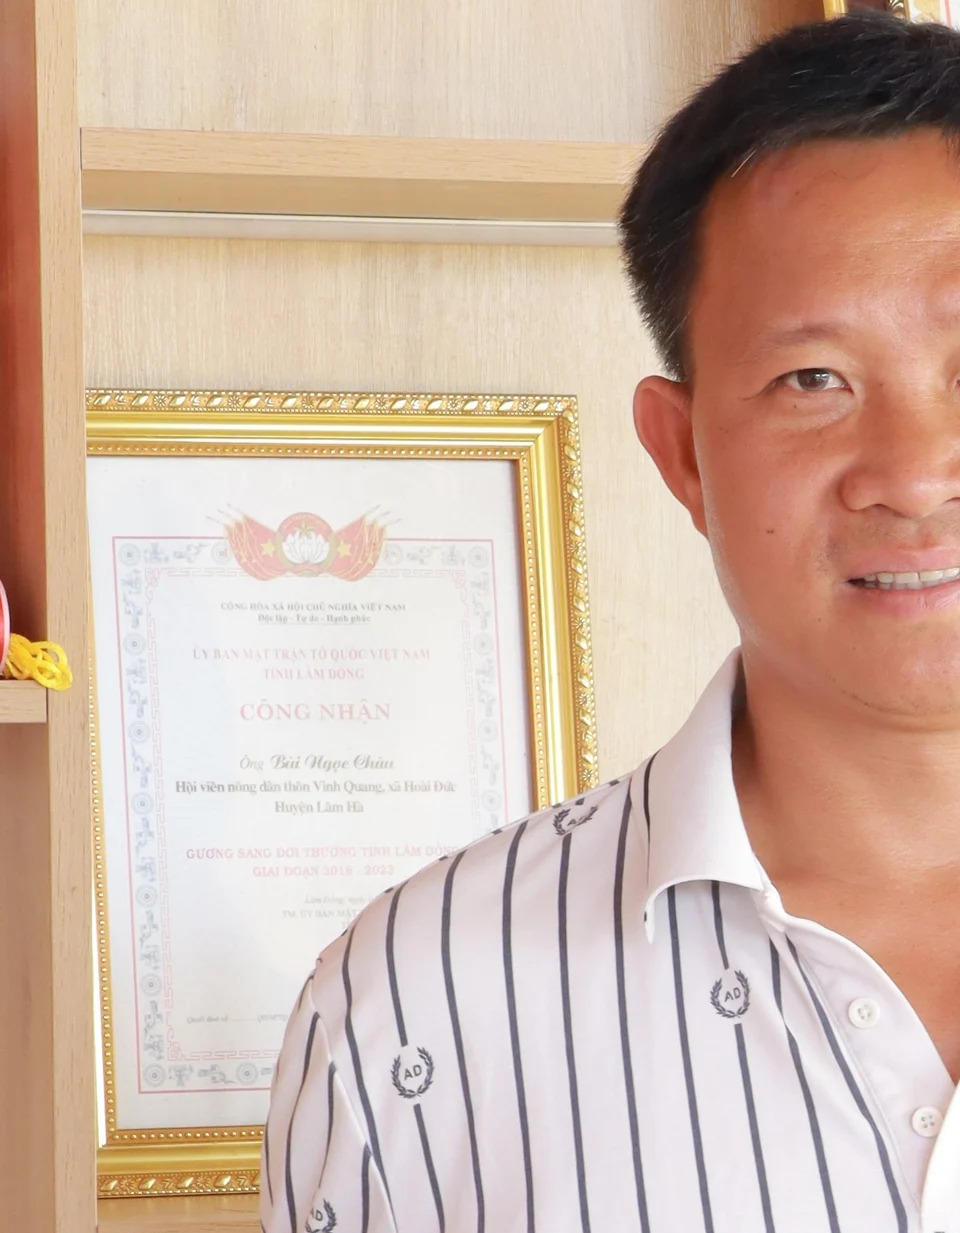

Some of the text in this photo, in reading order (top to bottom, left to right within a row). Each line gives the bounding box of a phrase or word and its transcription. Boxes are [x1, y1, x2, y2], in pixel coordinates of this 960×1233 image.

[239, 698, 390, 724] CÔNG NHẬN
[724, 987, 741, 1002] AD
[404, 1064, 422, 1080] AD
